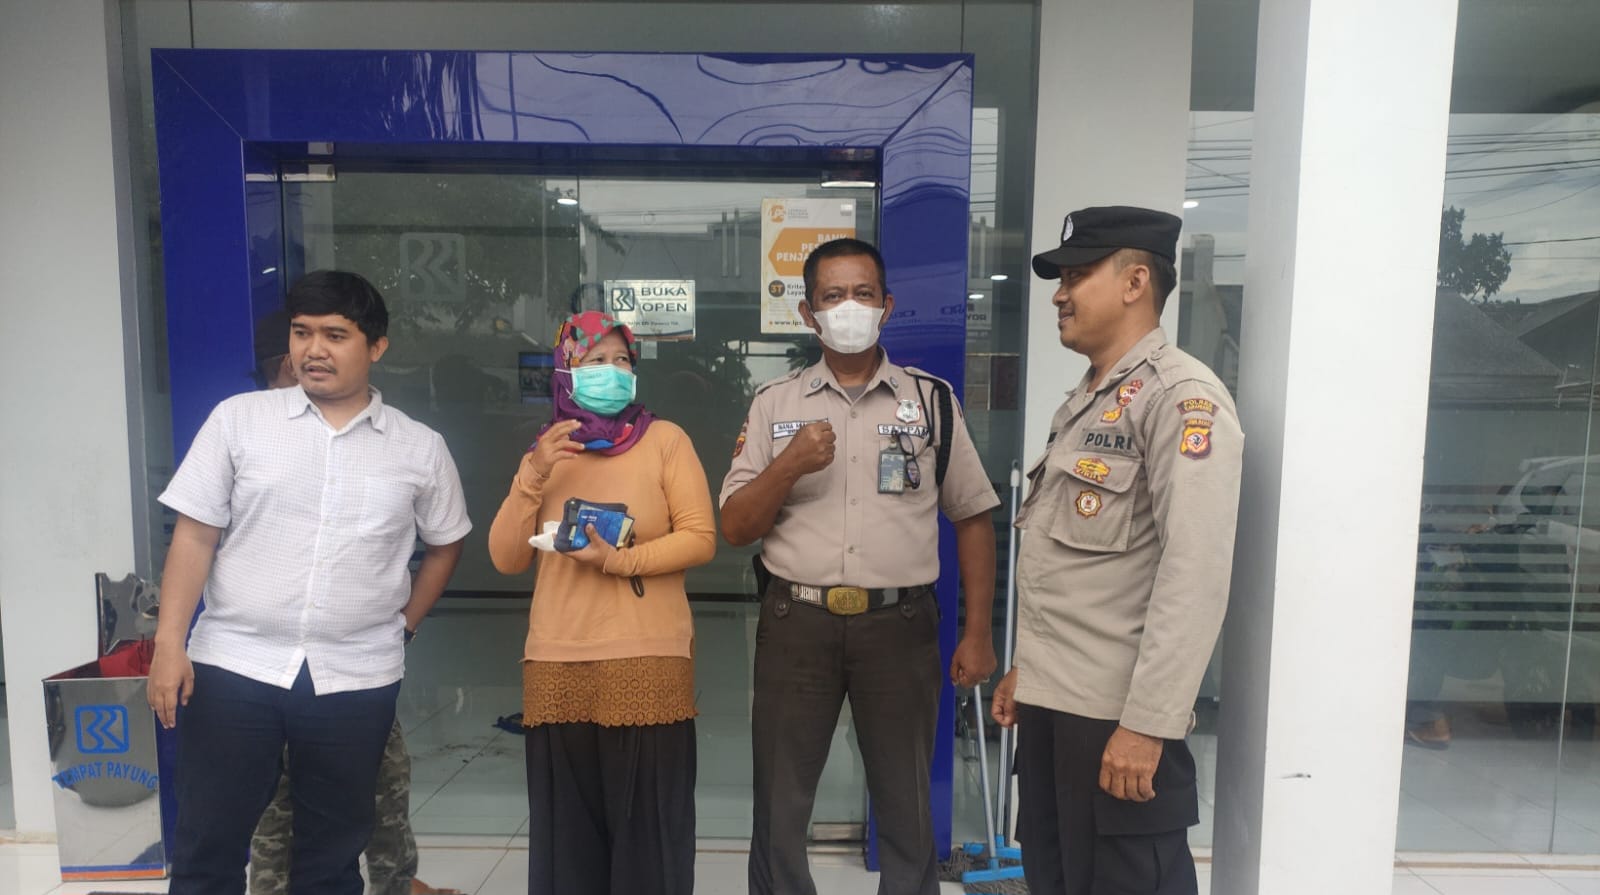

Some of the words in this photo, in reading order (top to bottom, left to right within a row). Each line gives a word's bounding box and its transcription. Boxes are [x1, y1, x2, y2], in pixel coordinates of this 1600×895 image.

[641, 287, 687, 296] BUKA
[642, 303, 687, 312] OPEN
[1085, 432, 1132, 450] POLRI
[106, 761, 159, 789] PAYUNG
